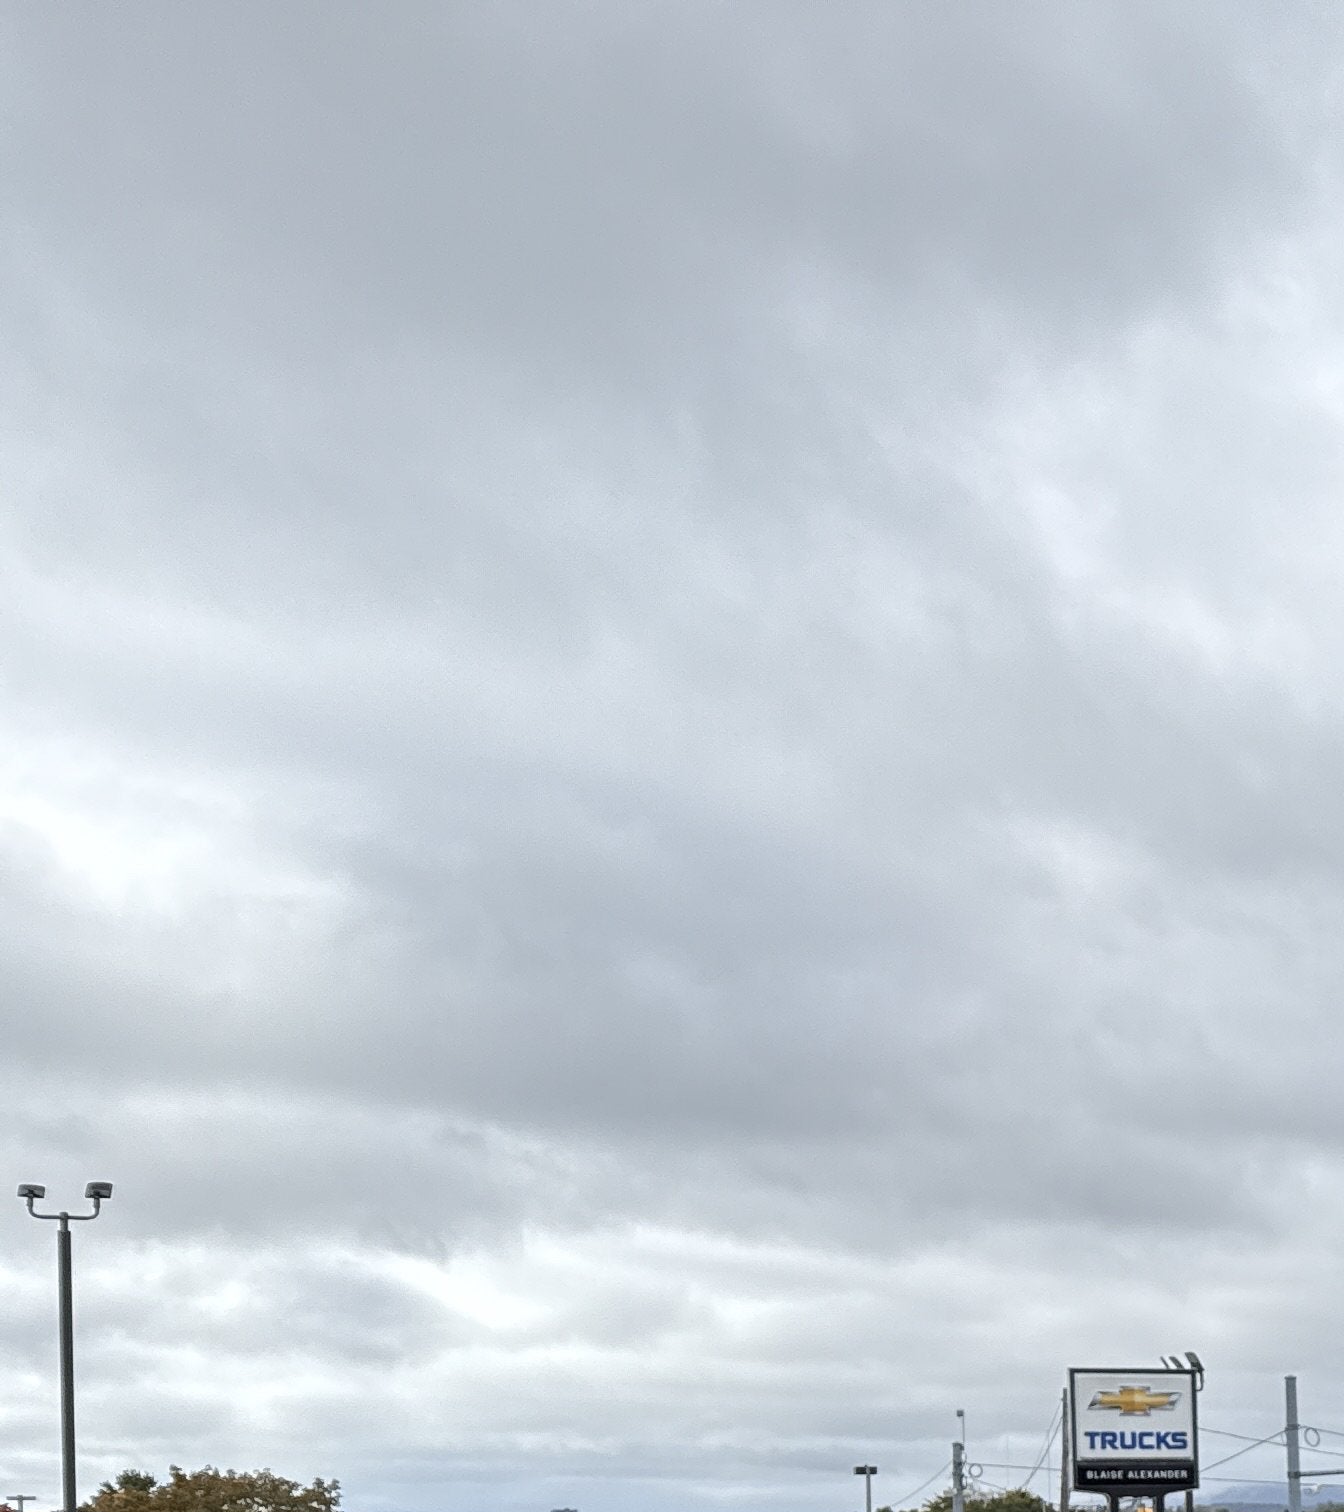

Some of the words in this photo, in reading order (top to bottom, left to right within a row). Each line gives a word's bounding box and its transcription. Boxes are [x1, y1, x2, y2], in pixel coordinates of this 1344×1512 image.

[1084, 1431, 1188, 1450] TRUCKS
[1086, 1470, 1123, 1480] BLAISE
[1127, 1469, 1188, 1480] ALEXANDER
